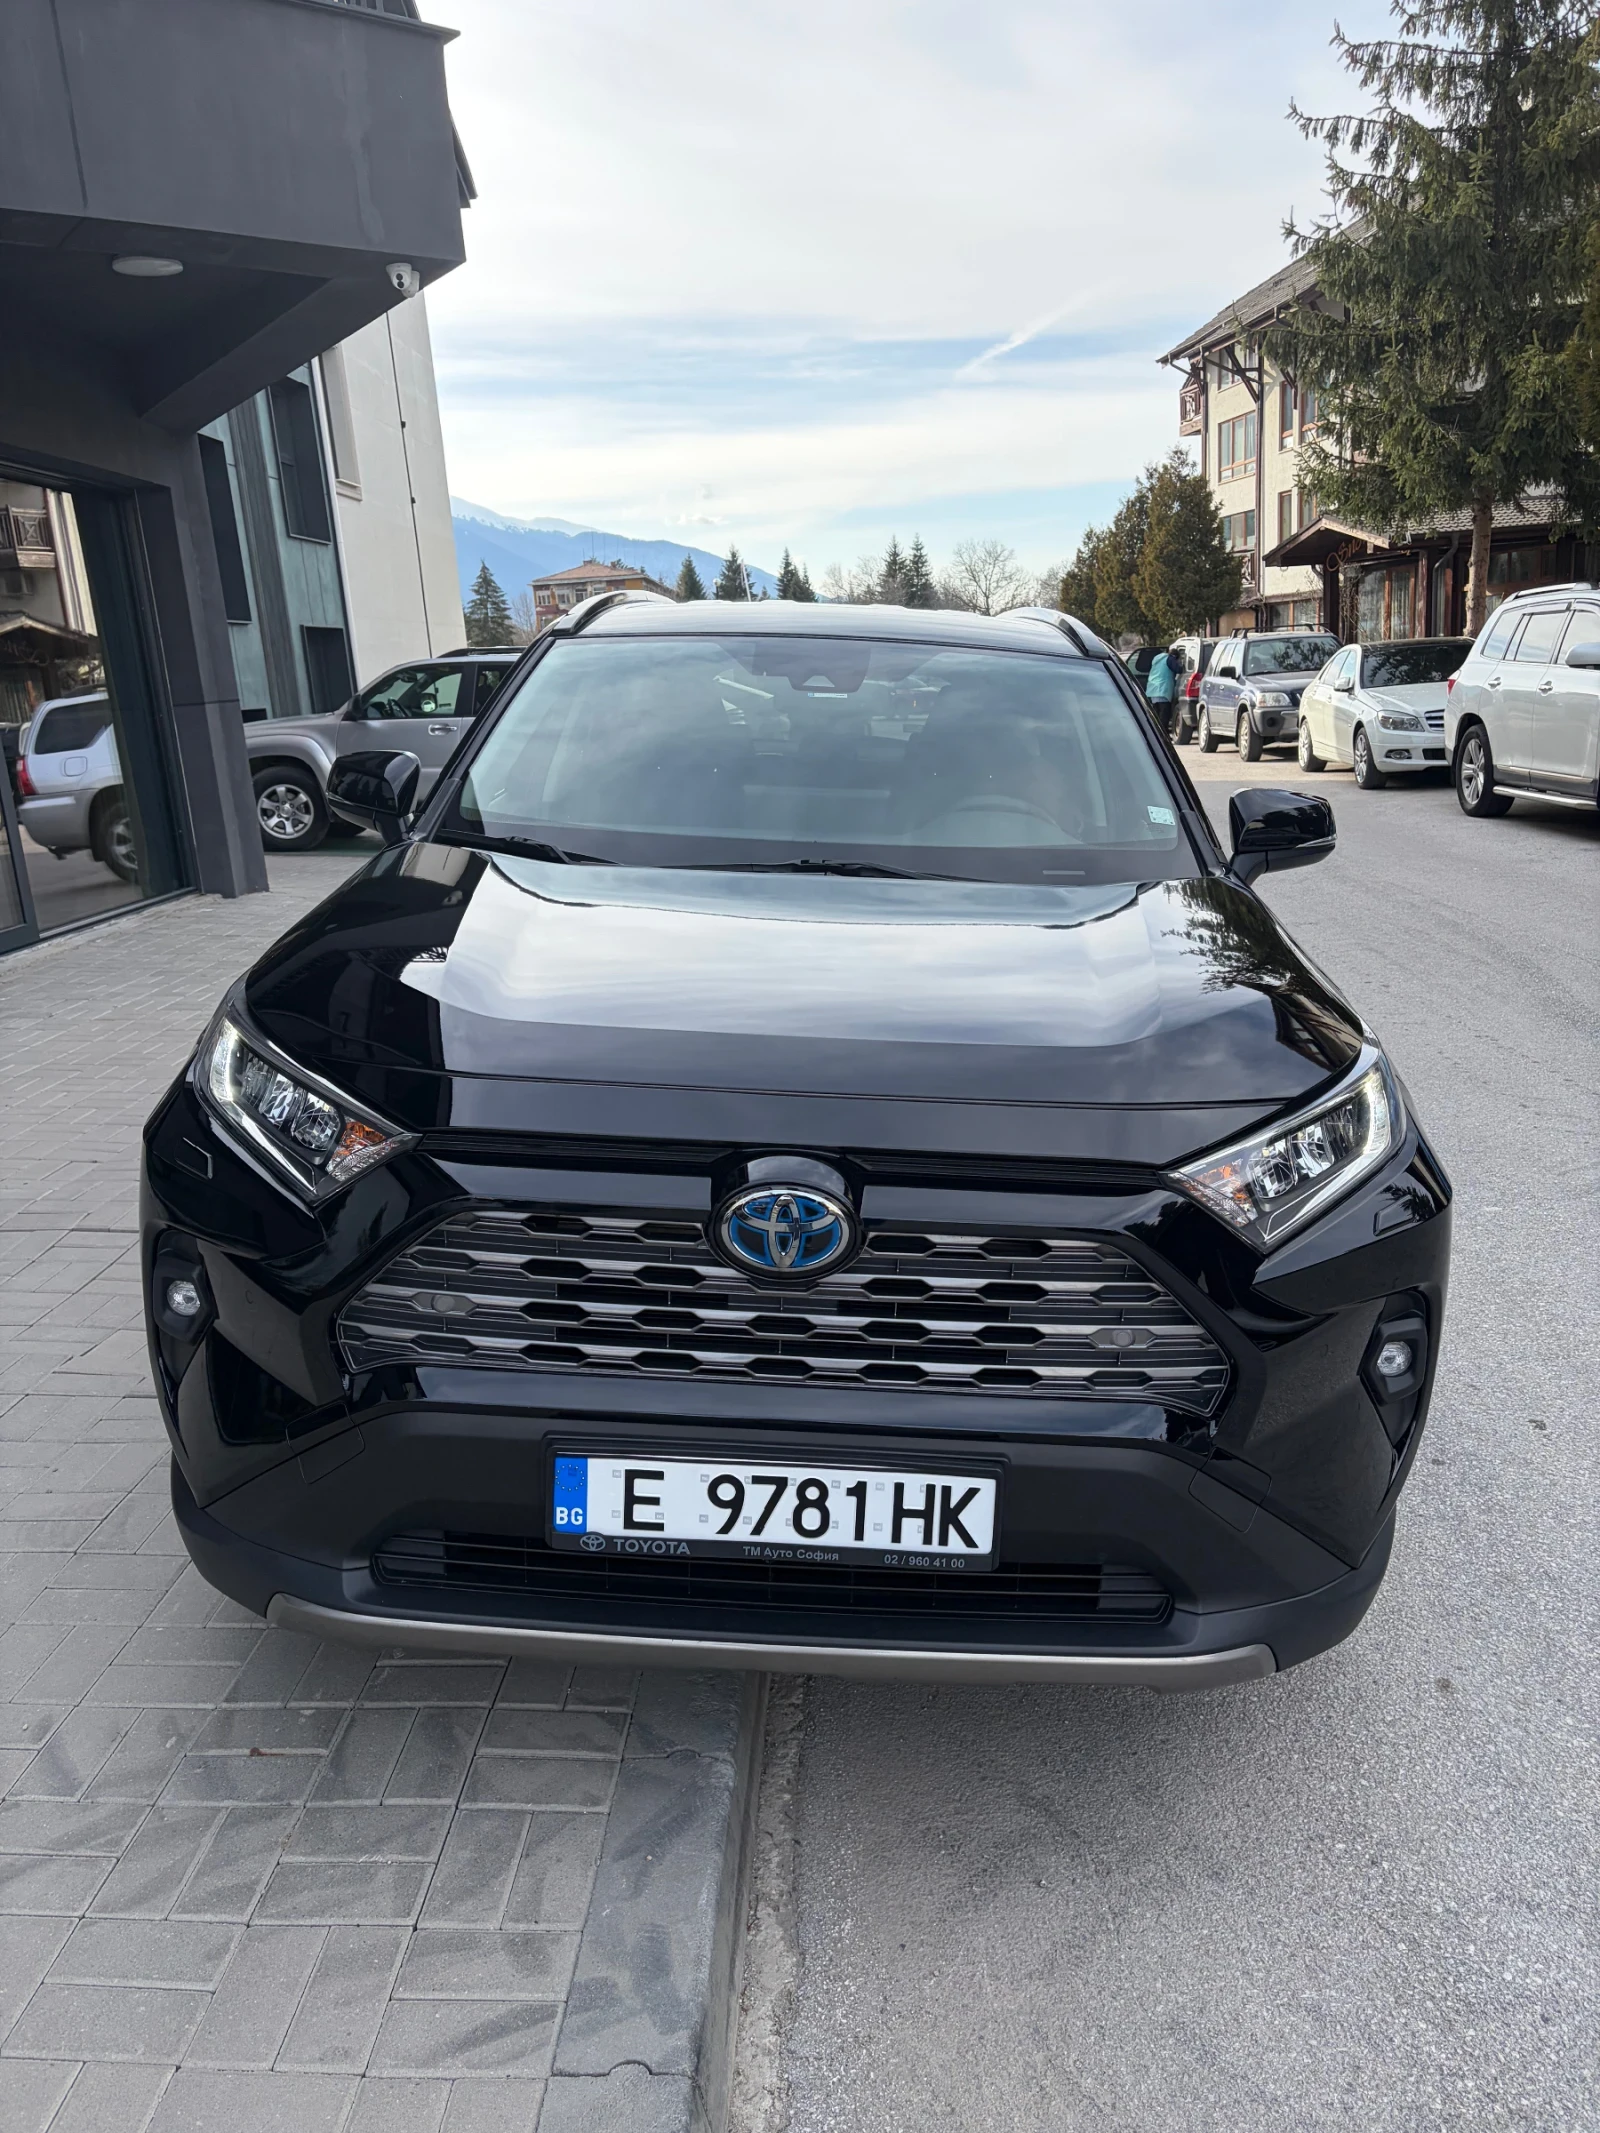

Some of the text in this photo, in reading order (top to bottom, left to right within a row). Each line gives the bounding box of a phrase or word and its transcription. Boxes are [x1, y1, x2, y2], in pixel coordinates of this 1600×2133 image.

[556, 1507, 583, 1525] BG
[623, 1469, 981, 1548] E 9781 HK
[613, 1538, 691, 1555] TOYOTA
[763, 1547, 793, 1559] Ауто
[797, 1549, 839, 1562] София
[884, 1554, 965, 1569] 02 / 960 41 00
